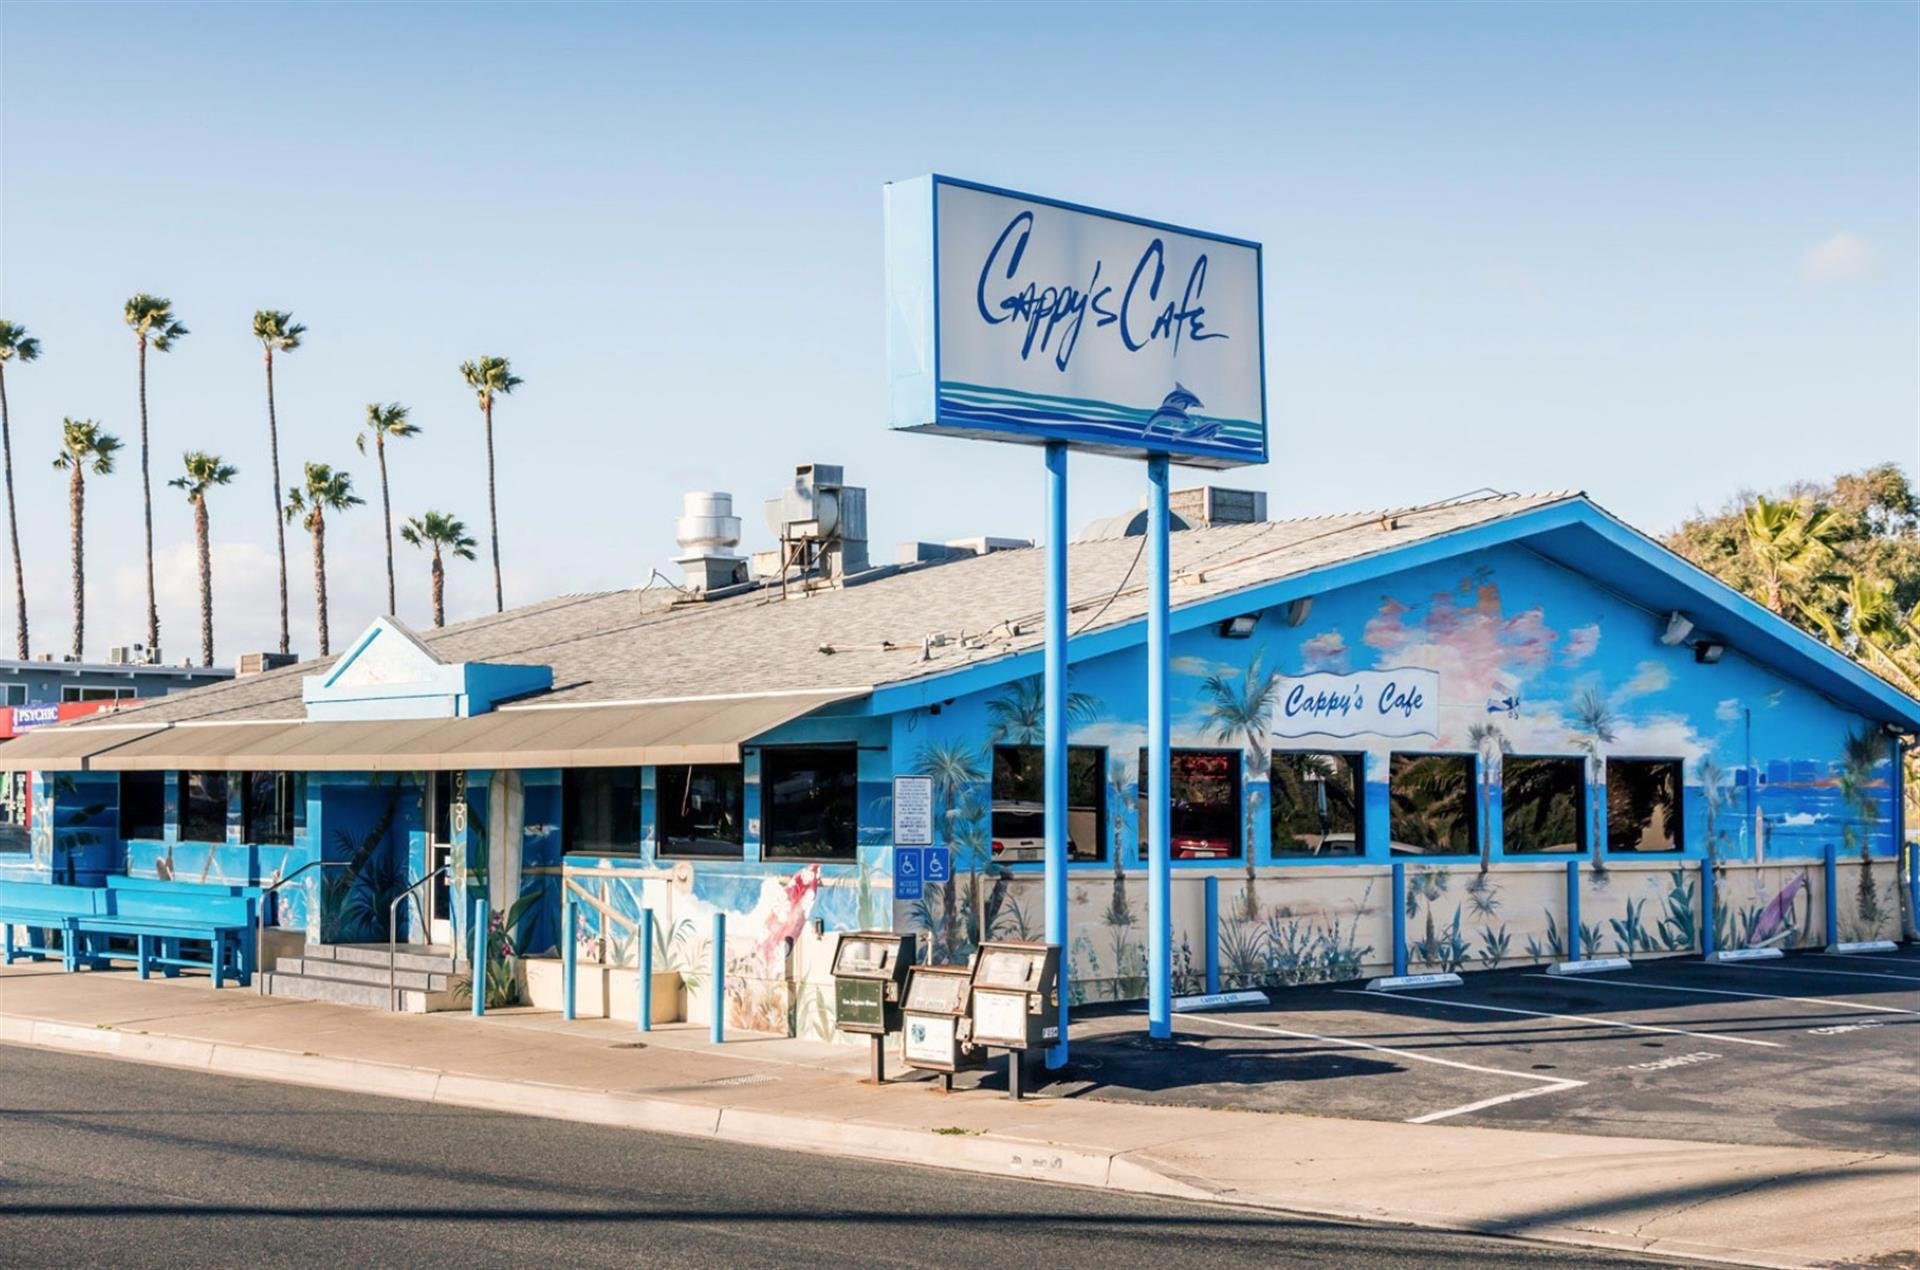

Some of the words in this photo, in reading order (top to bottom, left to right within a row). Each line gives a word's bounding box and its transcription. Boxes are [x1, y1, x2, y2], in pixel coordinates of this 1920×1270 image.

[1285, 683, 1364, 718] Cappy's
[1379, 682, 1424, 718] Cafe
[18, 707, 58, 721] PSYCHIC
